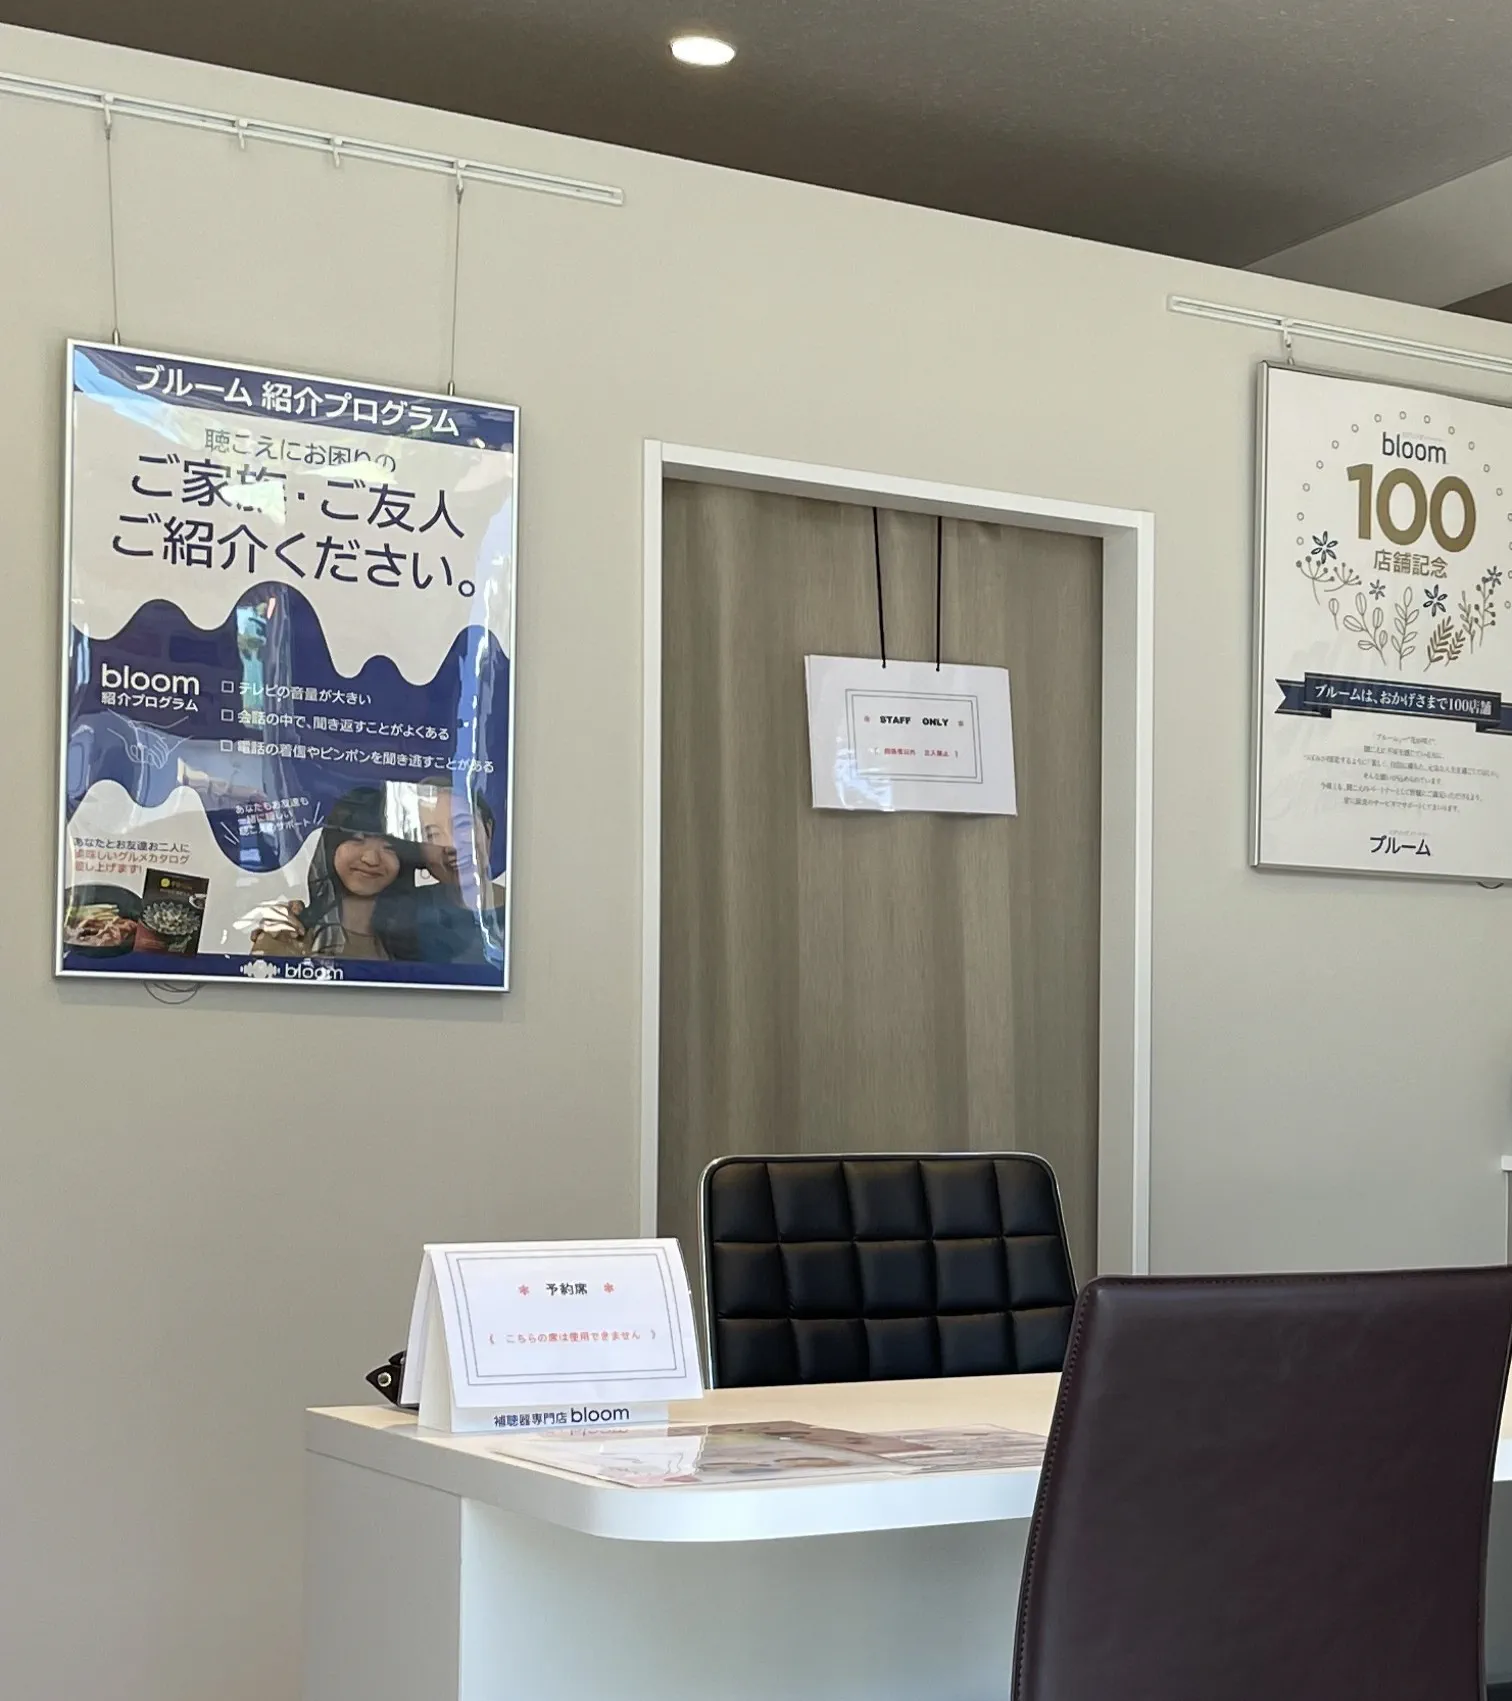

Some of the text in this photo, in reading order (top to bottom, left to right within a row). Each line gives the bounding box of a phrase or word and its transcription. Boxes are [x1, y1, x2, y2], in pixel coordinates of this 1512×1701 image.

[135, 363, 460, 437] ブルーム 紹介プログラム
[1382, 431, 1447, 464] bloom
[1346, 463, 1477, 553] 100
[112, 512, 477, 598] ご紹介ください。
[1373, 549, 1449, 579] 店舗記念
[101, 663, 200, 695] bloom
[101, 691, 199, 712] 紹介プログラム
[238, 683, 372, 705] テレビの音量が大きい
[1314, 683, 1492, 716] ブルームは、おかげさまで100店舗
[237, 711, 450, 740] 会話の中で、聞き返すことがよくある
[880, 715, 949, 727] STAFF ONLY
[1370, 834, 1431, 857] ブルーム
[545, 1282, 588, 1296] 予約席
[505, 1329, 641, 1344] こちらの席は使用できません
[494, 1405, 630, 1428] 補聴器専門店 bloom
